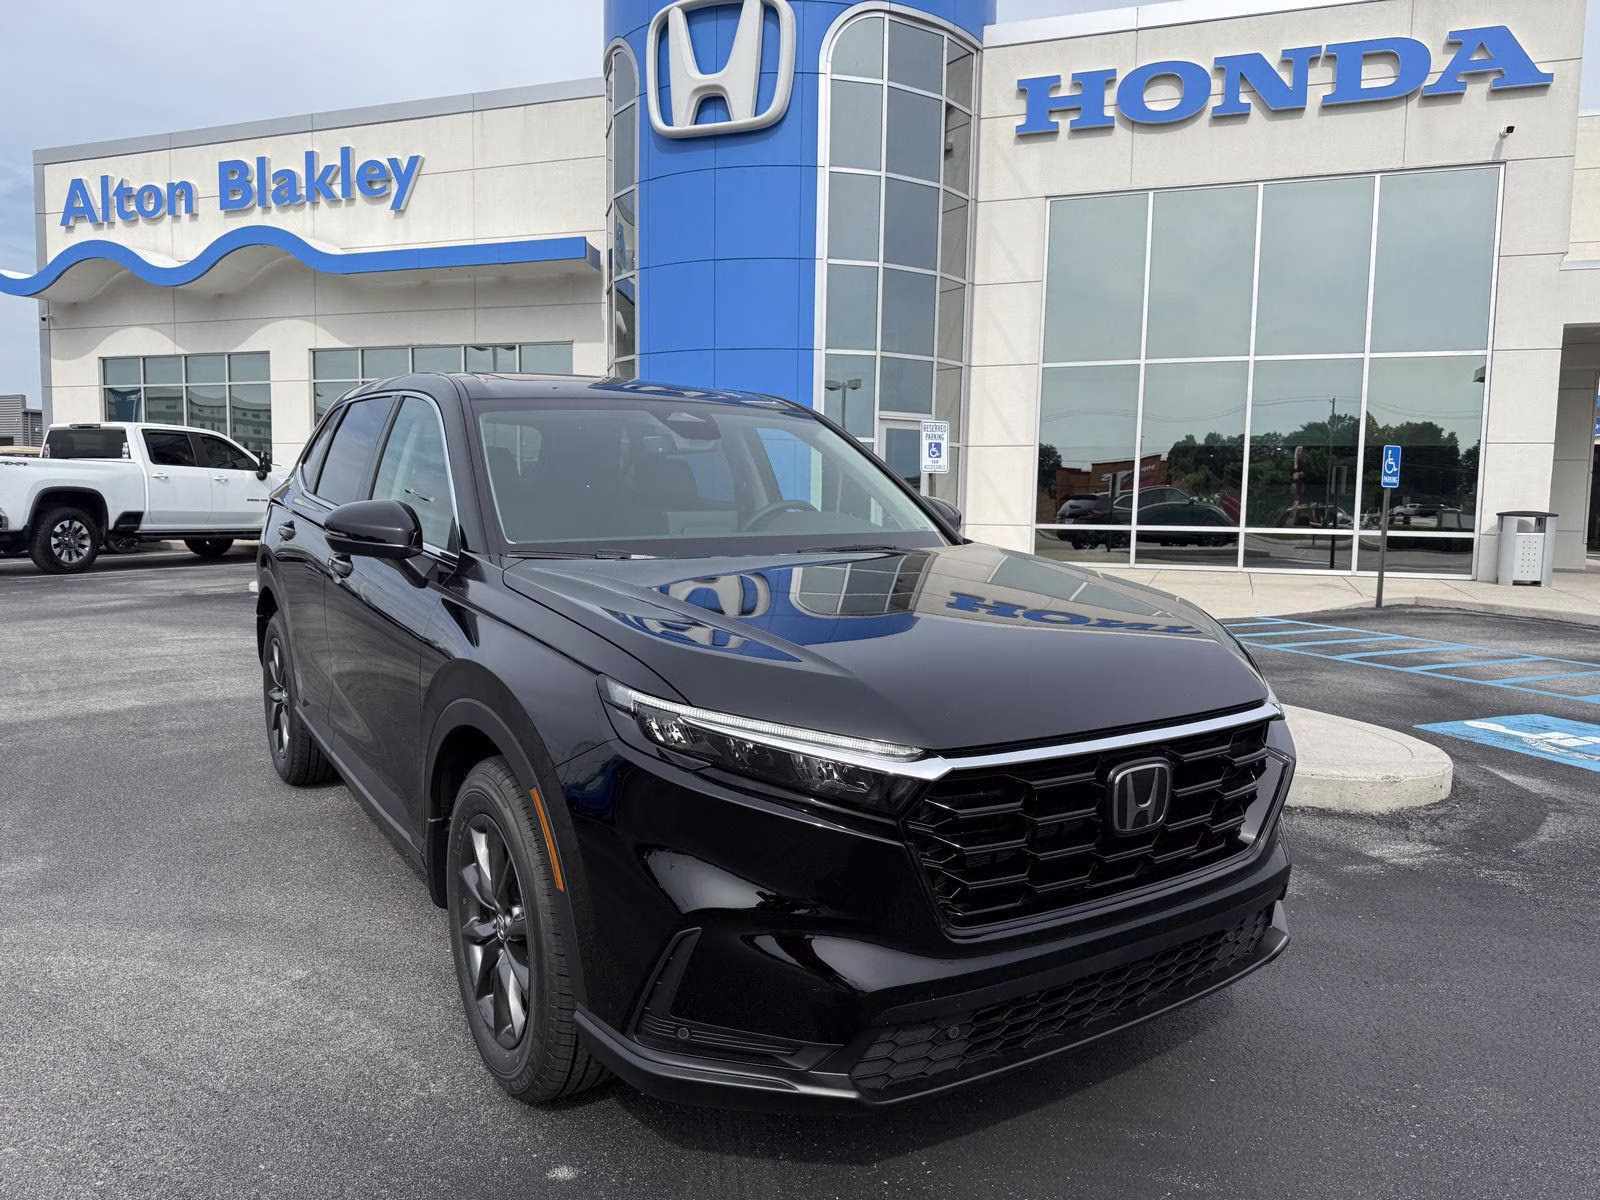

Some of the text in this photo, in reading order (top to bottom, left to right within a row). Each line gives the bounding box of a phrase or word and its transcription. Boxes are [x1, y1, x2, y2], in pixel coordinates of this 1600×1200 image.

[1015, 25, 1554, 136] HONDA
[60, 146, 424, 229] Alton Blakley
[923, 424, 947, 433] RESERVED
[925, 433, 945, 441] PARKING
[1383, 475, 1398, 484] PARKING
